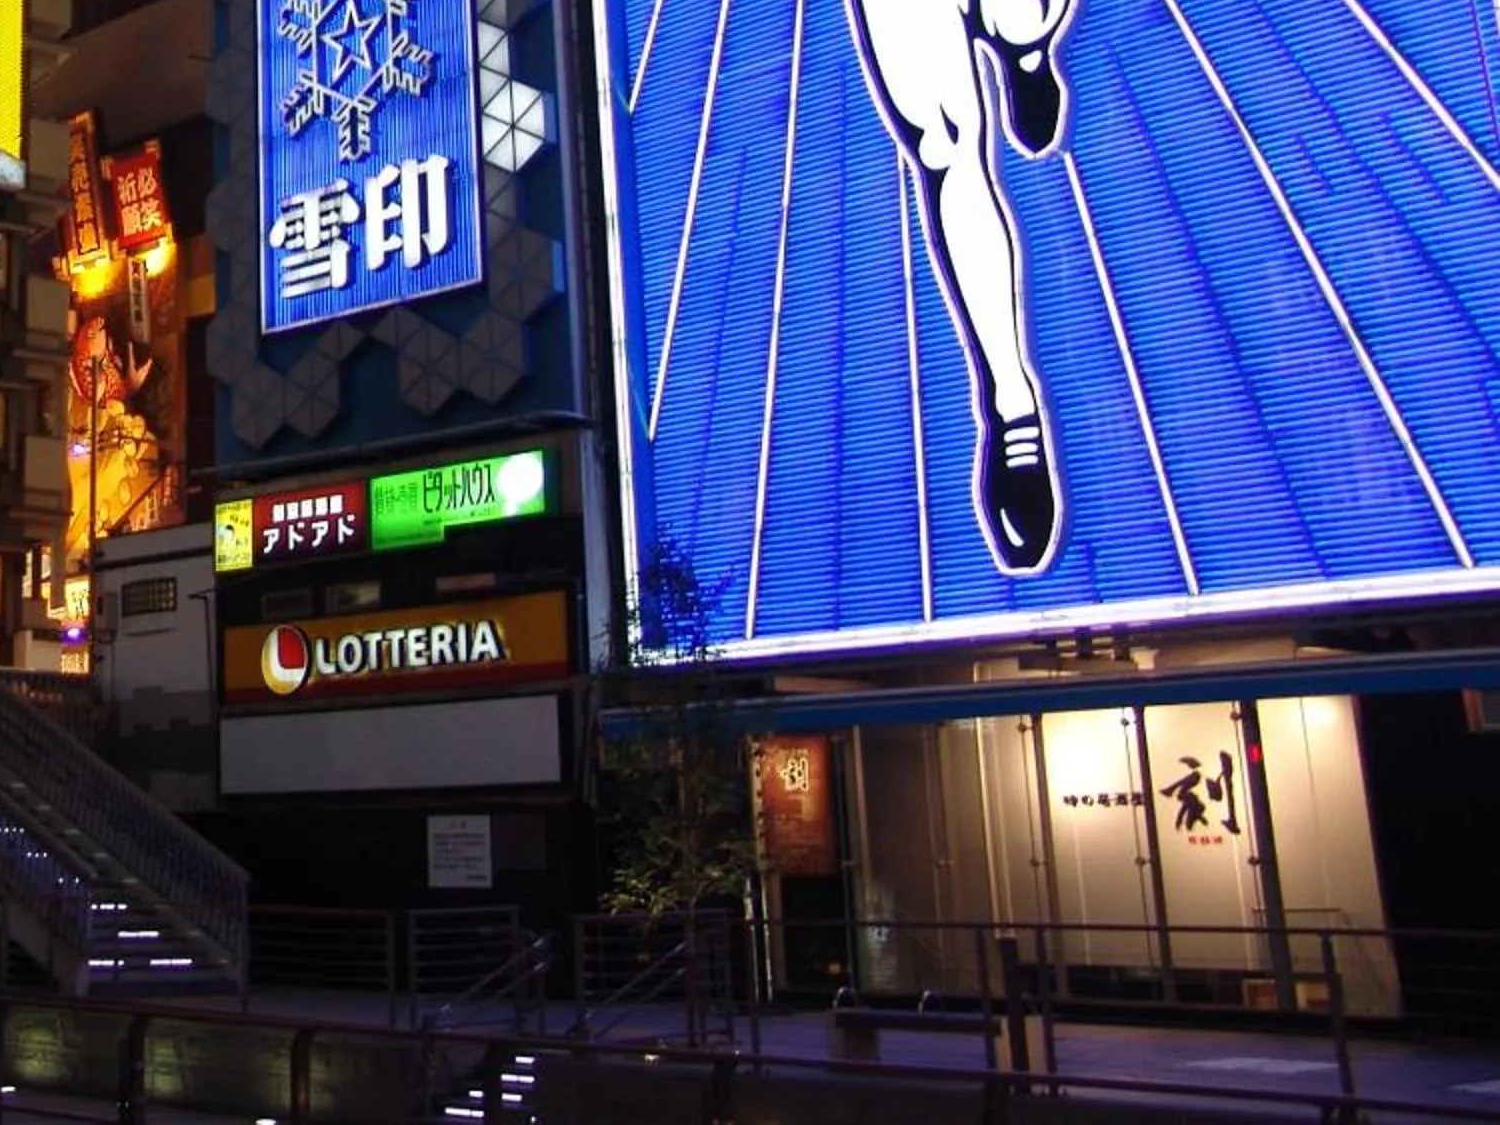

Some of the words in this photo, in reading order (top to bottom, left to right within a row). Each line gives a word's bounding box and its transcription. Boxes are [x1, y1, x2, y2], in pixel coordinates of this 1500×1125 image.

[269, 154, 449, 299] 雪印
[263, 513, 356, 554] アドアド
[315, 619, 500, 676] LOTTERIA
[1158, 750, 1241, 835] 刻
